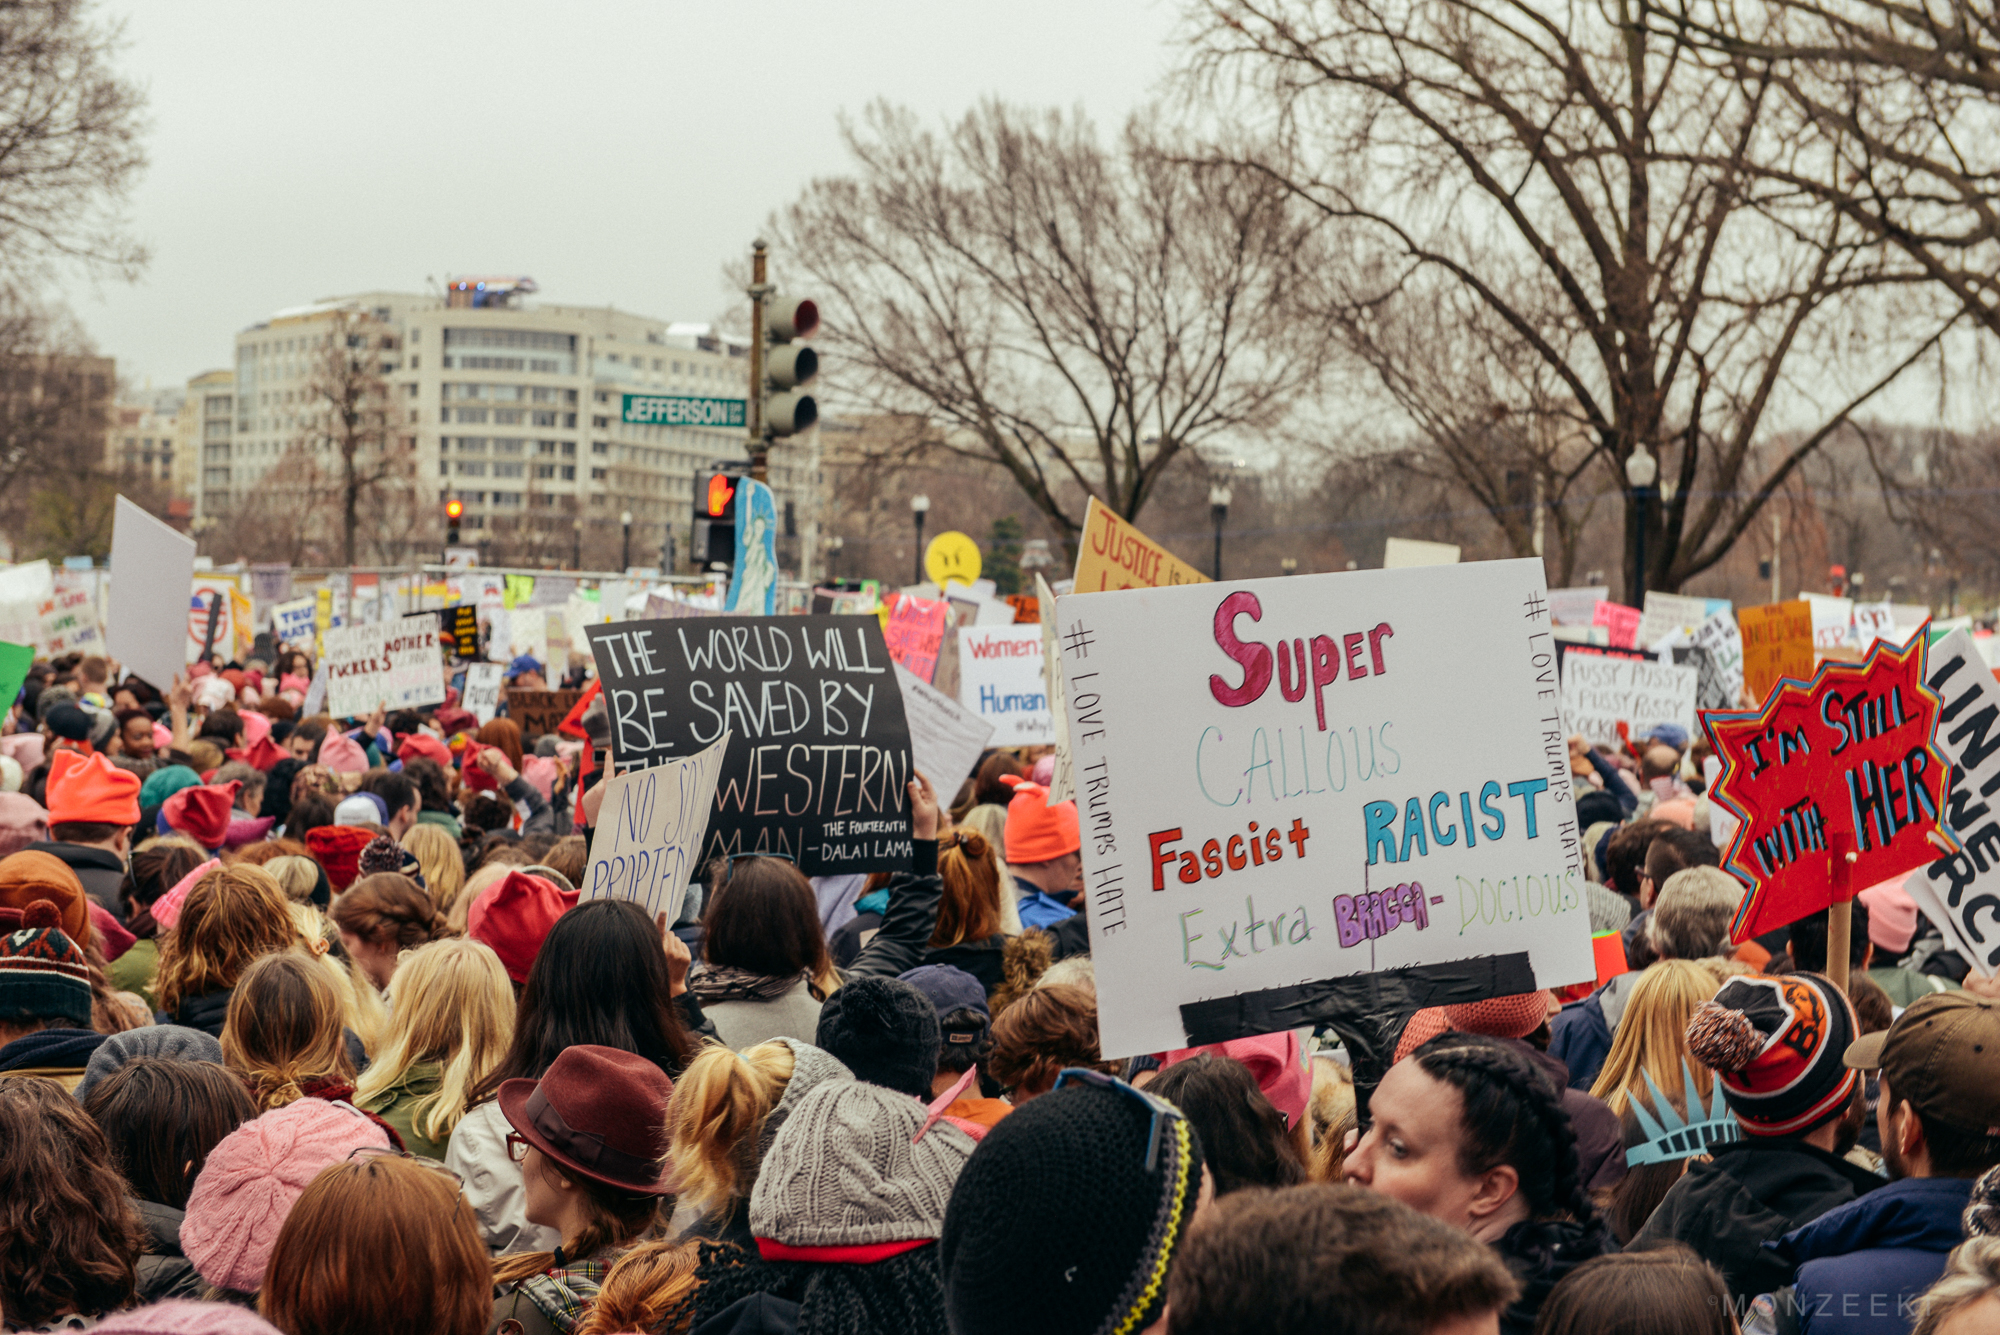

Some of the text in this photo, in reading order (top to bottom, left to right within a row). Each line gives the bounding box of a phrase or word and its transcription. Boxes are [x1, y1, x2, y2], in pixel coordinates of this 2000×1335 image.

[625, 397, 728, 424] JEFFERSON
[1092, 508, 1163, 587] JUSTICE
[594, 630, 666, 678] THE
[678, 626, 793, 673] WORLD
[801, 626, 885, 674] WILL
[968, 634, 1044, 660] Women
[1570, 659, 1688, 692] PUSSY PUSSY
[611, 688, 674, 754] BE
[689, 680, 811, 744] SAVED
[820, 679, 874, 738] BY
[980, 684, 1046, 714] Human
[1579, 690, 1632, 712] PUSSY
[1634, 693, 1685, 718] PUSSY
[1742, 684, 1920, 782] I'M STILL
[715, 744, 908, 817] WESTERN
[1196, 721, 1401, 807] CALLOUS
[1528, 632, 1556, 700] LOVE
[1557, 820, 1582, 876] HATE
[614, 772, 657, 853] NO
[823, 820, 907, 837] THE FOURTEENTH
[1071, 672, 1106, 746] LOVE
[1092, 863, 1127, 937] HATE
[1148, 777, 1548, 892] Fascist RACIST
[1752, 746, 1939, 878] WITH HER
[874, 839, 914, 858] LAMA
[1179, 895, 1317, 970] Extra
[1455, 870, 1581, 936] DOCIOUS
